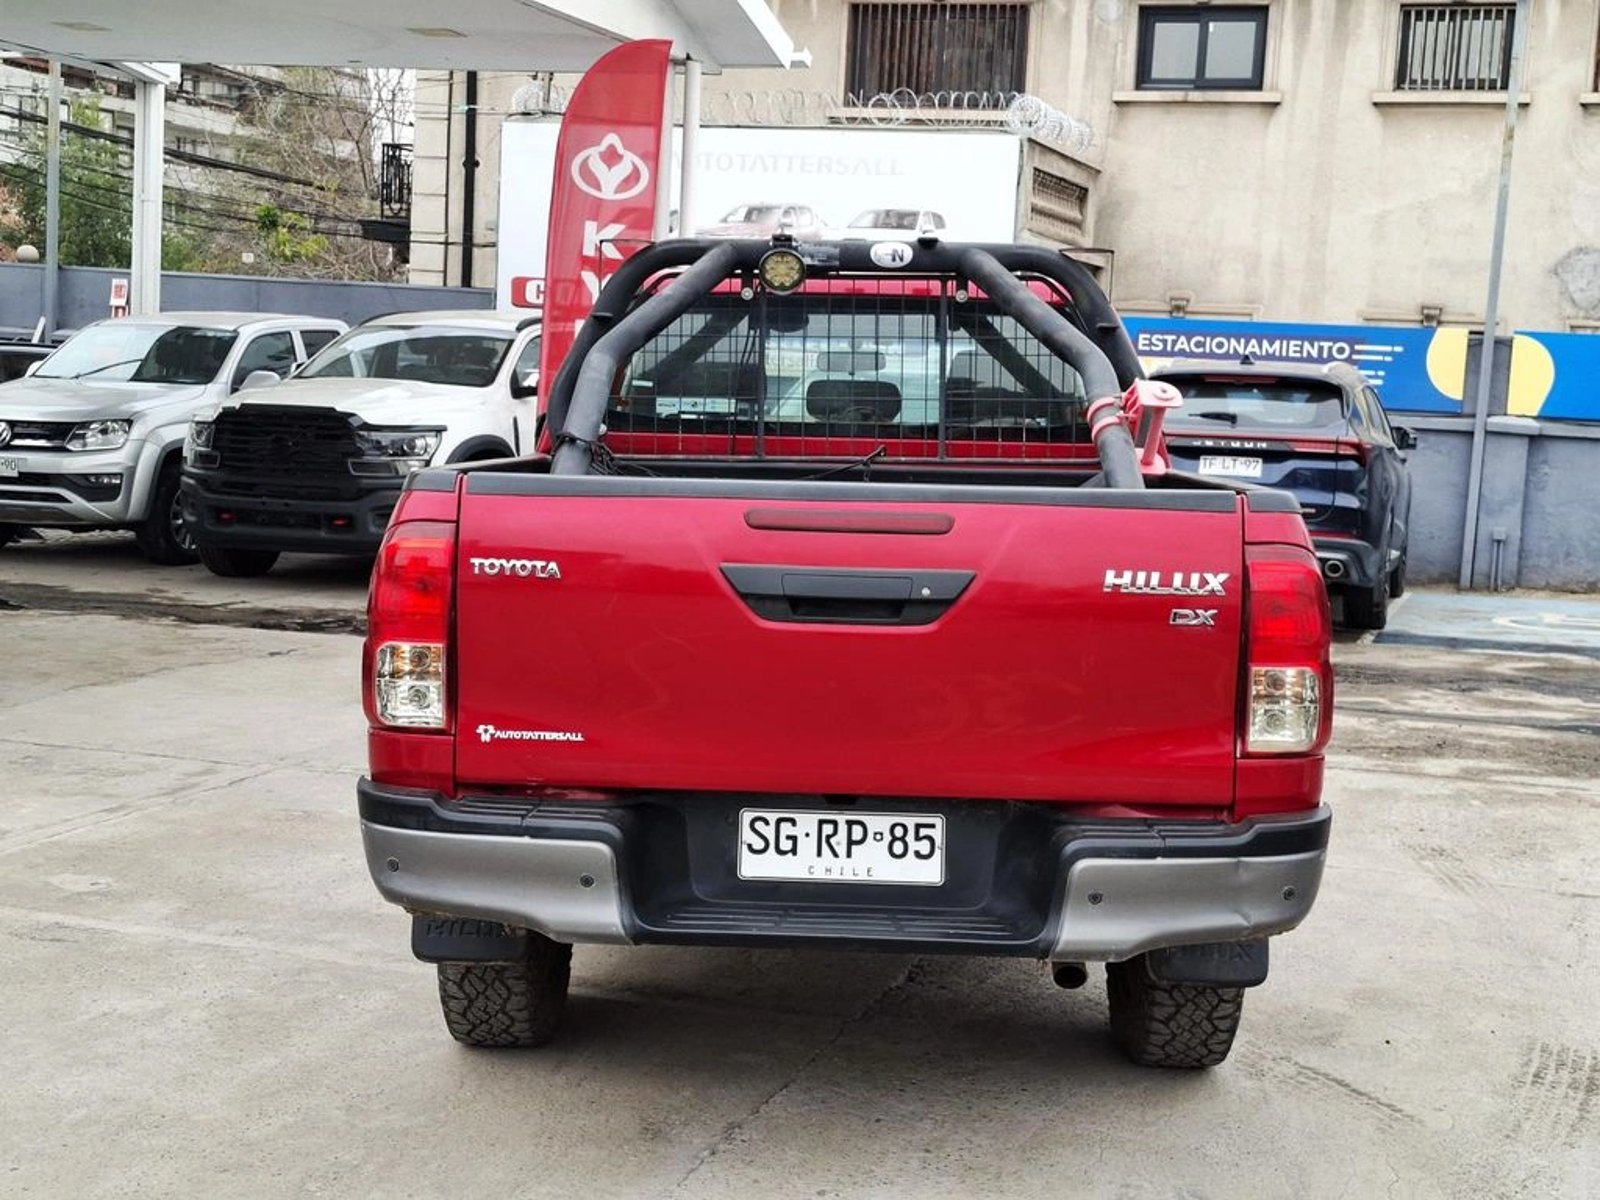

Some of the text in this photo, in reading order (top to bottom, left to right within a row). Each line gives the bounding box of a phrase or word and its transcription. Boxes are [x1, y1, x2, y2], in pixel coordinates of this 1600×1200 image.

[1137, 333, 1351, 360] ESTACIONAMIENTO
[470, 557, 561, 579] TOYOTA
[1103, 569, 1230, 596] HILUX
[1169, 609, 1218, 625] DX
[494, 730, 585, 742] AUTOTATTERSALL
[808, 866, 873, 877] CHILE
